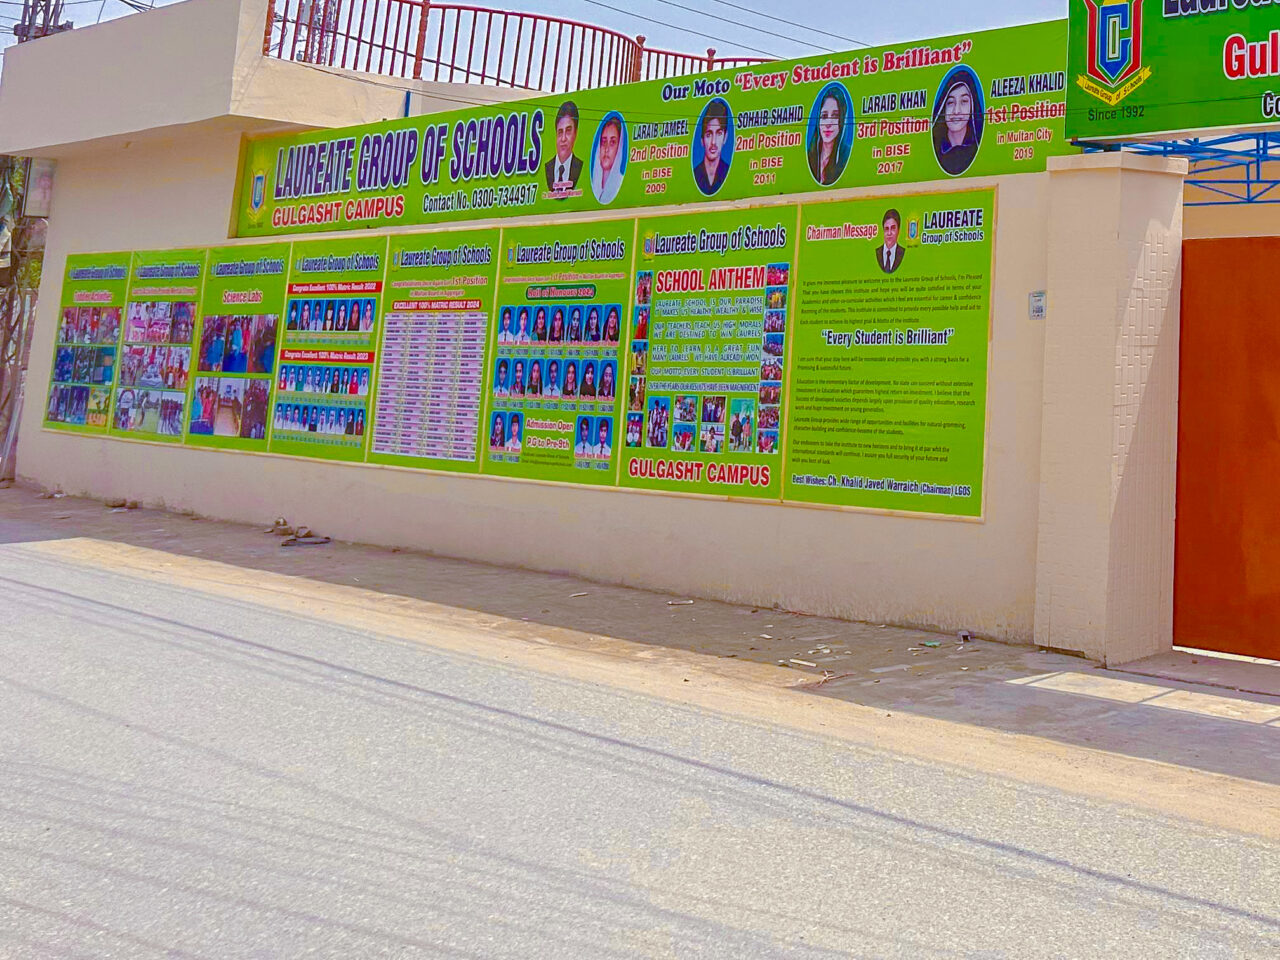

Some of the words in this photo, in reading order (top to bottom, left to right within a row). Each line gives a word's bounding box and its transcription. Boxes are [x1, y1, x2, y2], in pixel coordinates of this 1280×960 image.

[662, 83, 689, 102] Our
[692, 78, 731, 98] Moto
[791, 58, 860, 85] Student
[863, 56, 879, 74] is
[990, 76, 1026, 98] ALEEZA
[1028, 71, 1065, 94] KHALID
[861, 92, 898, 116] LARAIB
[899, 89, 927, 110] KHAN
[986, 104, 1008, 125] 1st
[1010, 100, 1066, 122] Position
[1088, 109, 1117, 121] Since
[1121, 105, 1145, 119] 1992
[736, 110, 769, 130] SOHAIB
[770, 105, 804, 125] SHAHID
[857, 121, 876, 139] 3rd
[879, 116, 930, 137] Position
[632, 122, 659, 141] LARAIB
[660, 119, 689, 138] JAMEEL
[997, 131, 1005, 144] in
[1006, 129, 1035, 144] Multan
[1036, 127, 1054, 143] City
[630, 147, 647, 163] 2nd
[649, 143, 689, 161] Position
[735, 136, 755, 153] 2nd
[757, 131, 802, 150] Position
[872, 147, 883, 159] in
[884, 143, 911, 157] BISE
[273, 137, 356, 200] LAUREATE
[356, 128, 419, 192] GROUP
[420, 123, 449, 185] OF
[449, 108, 545, 182] SCHOOLS
[749, 159, 759, 170] in
[760, 155, 784, 169] BISE
[1014, 147, 1034, 160] 2019
[642, 170, 651, 180] in
[651, 167, 672, 179] BISE
[753, 173, 776, 185] 2011
[877, 161, 904, 175] 2017
[423, 192, 455, 214] Contact
[456, 190, 470, 211] No.
[472, 182, 538, 209] 0300-7344917
[645, 183, 667, 194] 2009
[272, 200, 343, 228] GULGASHT
[345, 194, 405, 222] CAMPUS
[923, 208, 984, 231] LAUREATE
[654, 232, 697, 255] Laureate
[698, 228, 728, 256] Group
[731, 225, 743, 250] of
[744, 223, 786, 249] Schools
[806, 225, 842, 241] Chairman
[843, 222, 878, 240] Message
[921, 232, 943, 246] Group
[944, 231, 954, 243] of
[954, 230, 984, 243] Schools
[301, 255, 327, 273] Laureate
[327, 253, 346, 275] Group
[355, 251, 380, 272] Schools
[400, 249, 430, 268] Laureate
[431, 246, 452, 270] Group
[453, 245, 461, 264] of
[461, 244, 491, 265] Schools
[516, 241, 551, 264] Laureate
[552, 240, 578, 267] Group
[579, 238, 589, 260] of
[590, 238, 625, 261] Schools
[656, 270, 705, 293] SCHOOL
[708, 265, 766, 291] ANTHEM
[223, 288, 248, 304] Science
[854, 327, 892, 346] Student
[894, 328, 904, 344] is
[526, 418, 556, 430] Admission
[557, 419, 574, 433] Open
[538, 437, 545, 447] to
[629, 457, 705, 482] GULGASHT
[706, 462, 770, 487] CAMPUS
[841, 475, 863, 488] Khalid
[865, 477, 885, 490] Javed
[886, 478, 919, 492] Warraich
